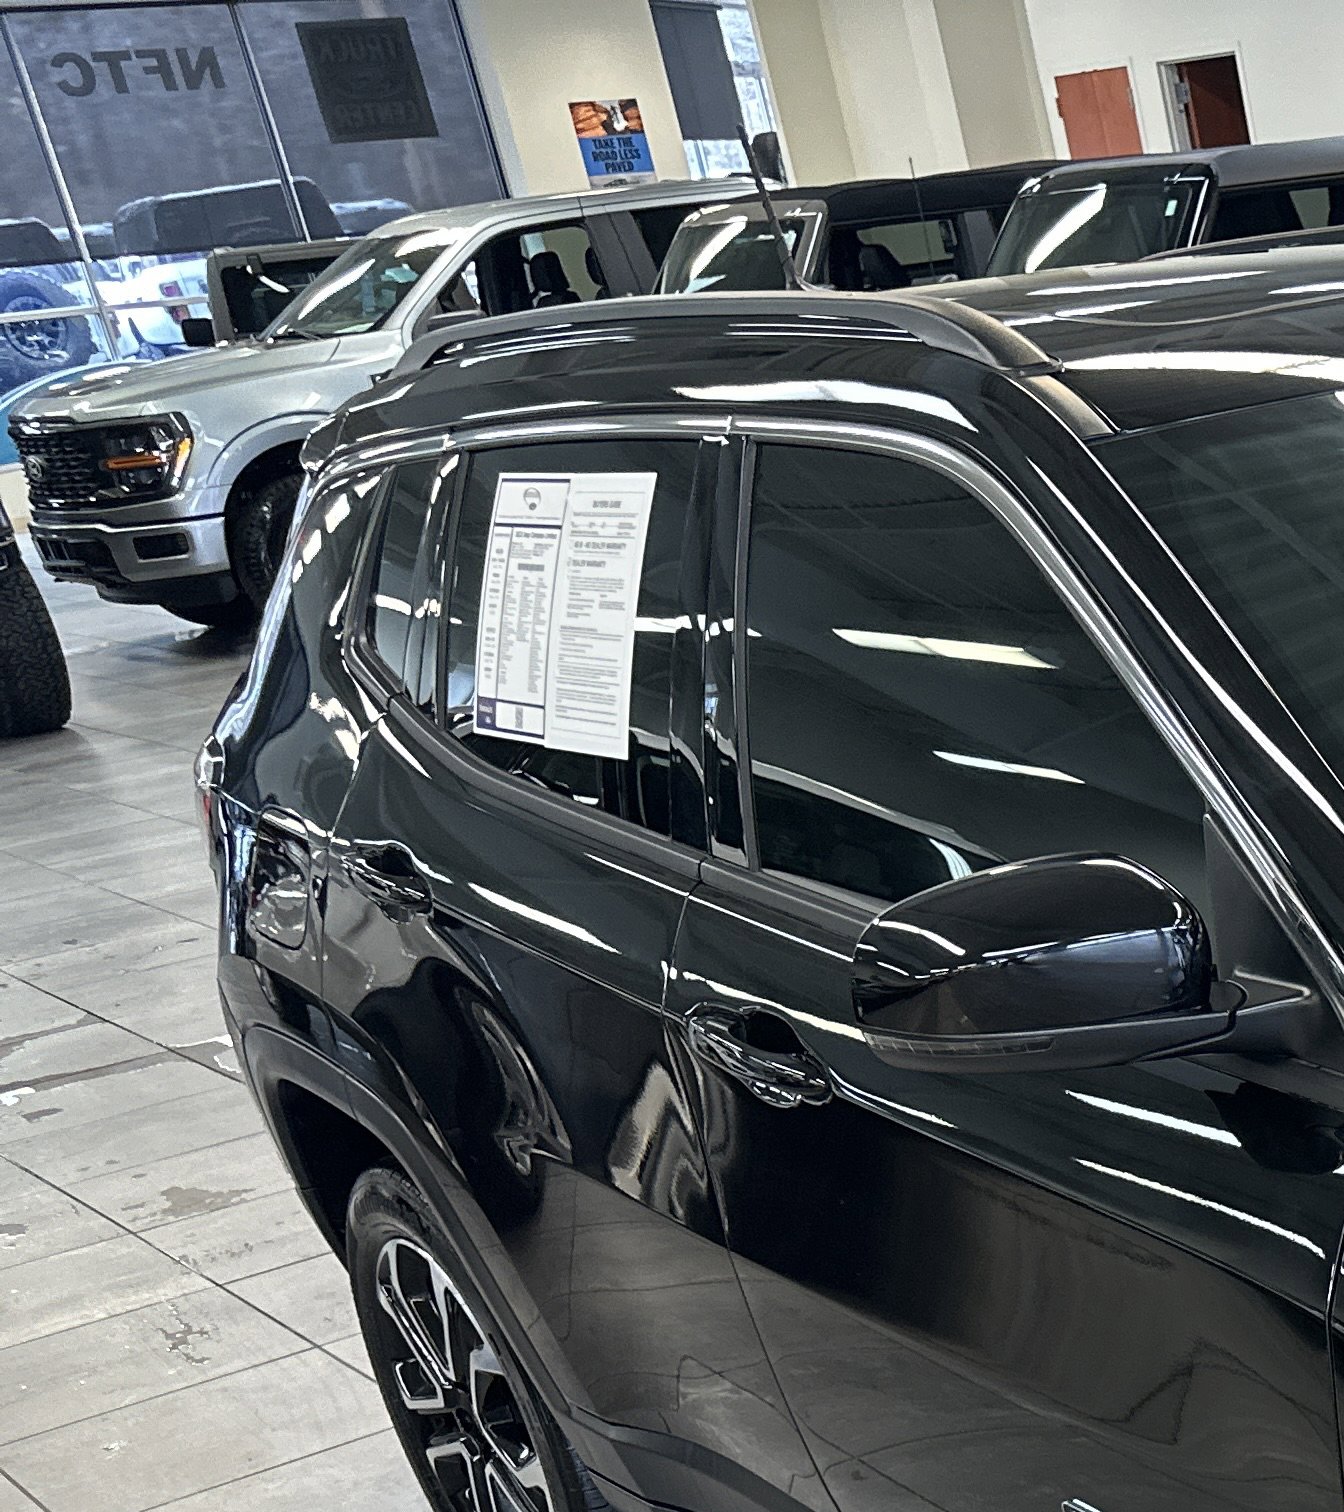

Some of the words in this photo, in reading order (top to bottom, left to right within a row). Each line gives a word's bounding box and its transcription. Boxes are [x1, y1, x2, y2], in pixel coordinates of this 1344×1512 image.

[591, 138, 616, 150] TAKE
[616, 136, 636, 148] THE
[591, 150, 618, 162] ROAD
[618, 148, 642, 160] LESS
[604, 160, 635, 173] PAVED
